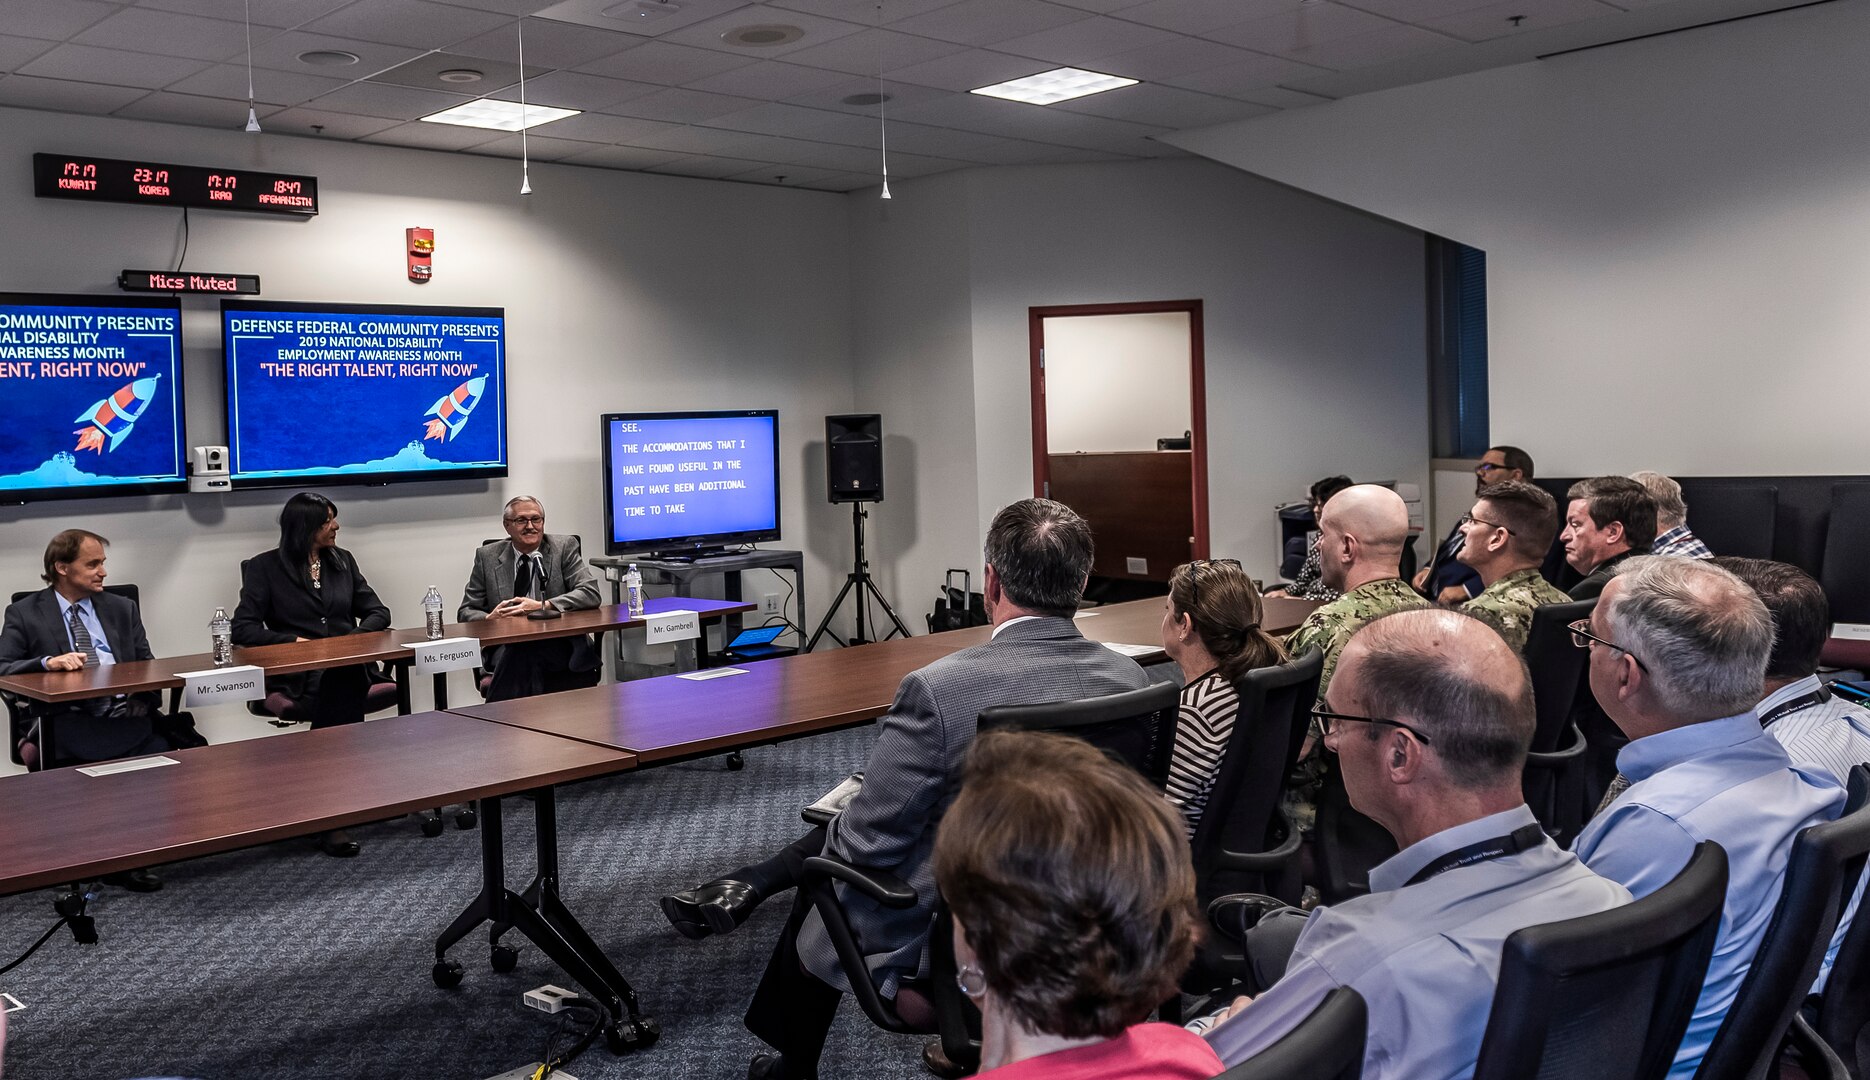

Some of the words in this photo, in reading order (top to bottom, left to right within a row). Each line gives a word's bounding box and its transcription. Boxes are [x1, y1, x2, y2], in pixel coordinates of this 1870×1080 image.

[64, 163, 96, 178] 17:17
[133, 169, 168, 184] 23:17
[58, 178, 97, 191] KUWAIT
[207, 175, 236, 189] 17:17
[274, 180, 301, 194] 18:47
[139, 184, 170, 196] KOREA
[209, 190, 233, 201] IRAQ
[259, 194, 312, 207] AFGHANISTN
[150, 274, 185, 289] Mics
[190, 276, 237, 291] Muted
[0, 314, 93, 330] OMMUNITY
[97, 316, 174, 331] PRESENTS
[231, 319, 294, 333] DEFENSE
[297, 320, 356, 334] FEDERAL
[359, 322, 439, 336] COMMUNITY
[441, 324, 500, 337] PRESENTS
[0, 331, 21, 344] AL
[23, 332, 99, 345] DISABILITY
[299, 336, 327, 347] 2019
[329, 336, 385, 348] NATIONAL
[387, 337, 444, 348] DISABILITY
[73, 347, 125, 359] MONTH
[278, 349, 356, 360] EMPLOYMENT
[358, 350, 421, 361] AWARENESS
[423, 351, 462, 361] MONTH
[40, 362, 93, 378] RIGHT
[97, 362, 146, 378] NOW"
[260, 362, 295, 377] "THE
[298, 363, 341, 377] RIGHT
[343, 363, 396, 379] TALENT,
[399, 363, 438, 377] RIGHT
[441, 363, 478, 377] NOW"
[621, 423, 642, 433] SEE.
[622, 444, 638, 454] THE
[642, 440, 713, 453] ACCOMMODATIONS
[716, 439, 736, 450] THAT
[740, 439, 746, 449] I
[623, 465, 644, 475] HAVE
[649, 463, 674, 474] FOUND
[678, 461, 708, 472] USEFUL
[712, 460, 723, 471] IN
[727, 459, 741, 470] THE
[624, 485, 645, 496] PAST
[649, 484, 670, 494] HAVE
[674, 482, 694, 493] BEEN
[698, 479, 747, 491] ADDITIONAL
[624, 506, 645, 517] TIME
[650, 505, 661, 515] TO
[665, 504, 685, 514] TAKE
[654, 626, 665, 634] Mr.
[667, 622, 693, 631] Gambrell
[424, 654, 438, 664] Ms.
[440, 650, 474, 661] Ferguson
[197, 685, 213, 695] Mr.
[216, 680, 255, 693] Swanson
